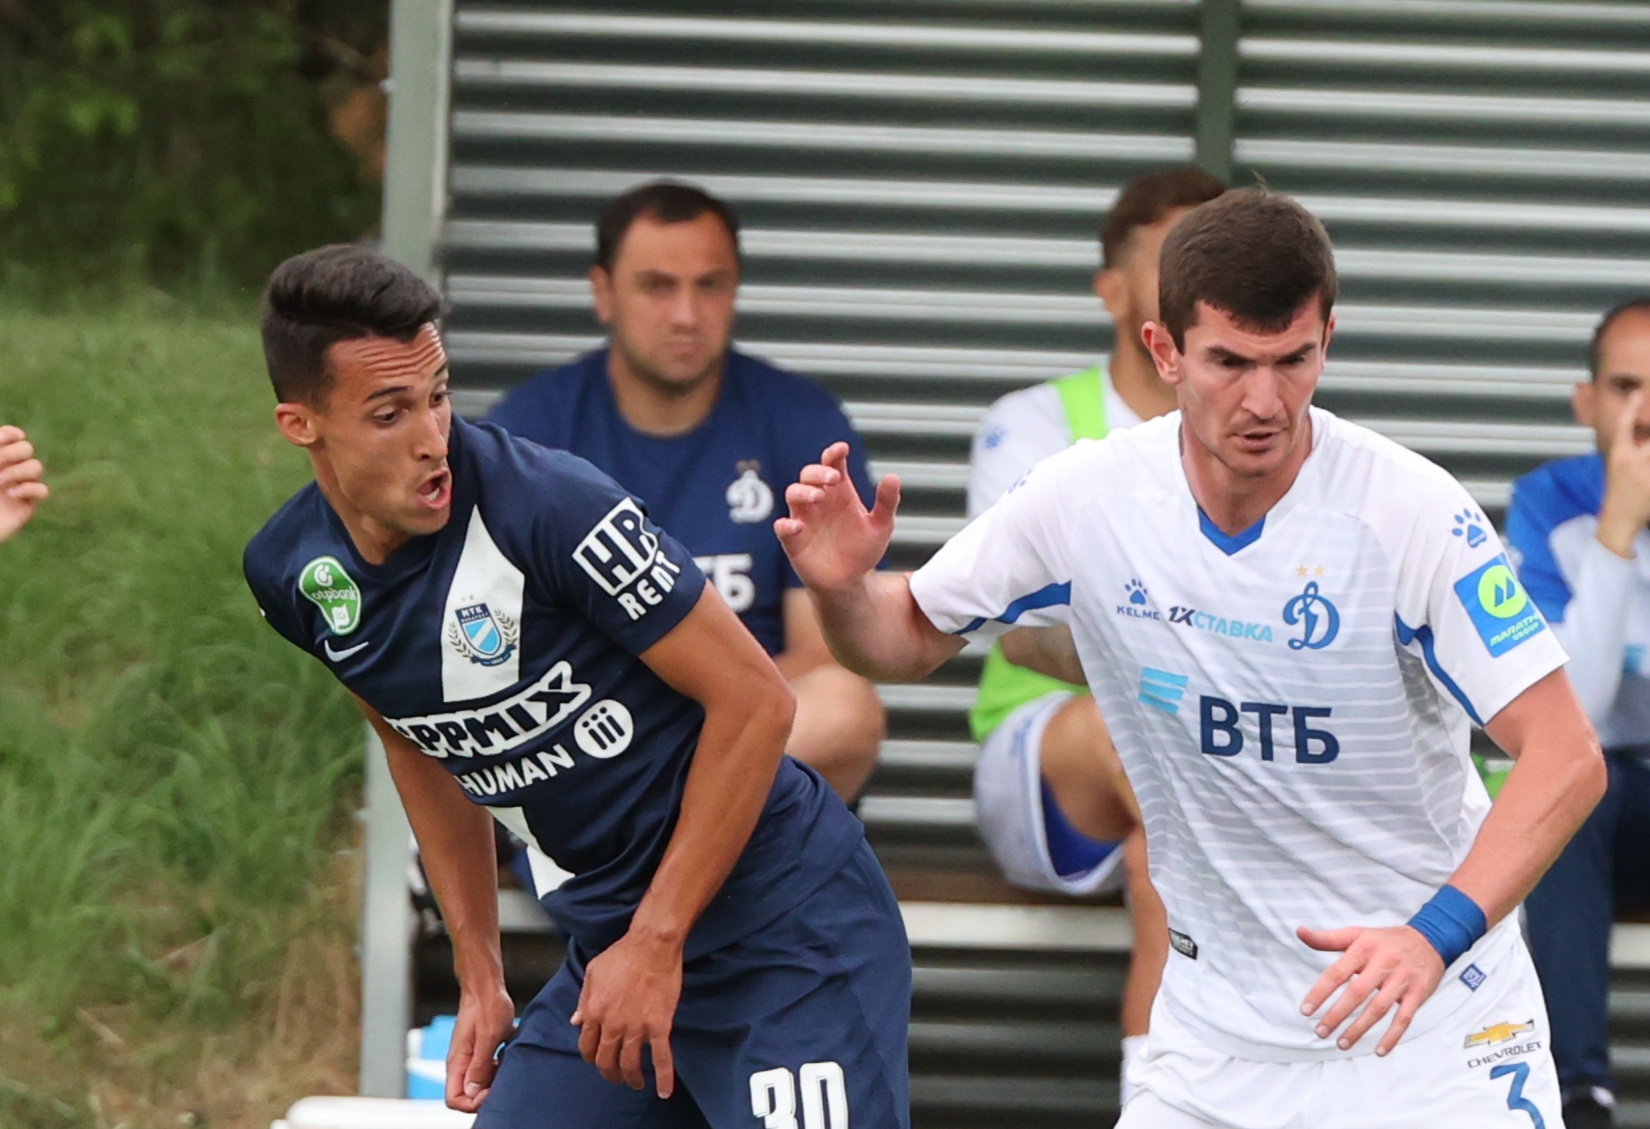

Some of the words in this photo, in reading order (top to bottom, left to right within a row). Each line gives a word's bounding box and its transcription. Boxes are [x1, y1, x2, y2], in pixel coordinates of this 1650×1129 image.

[1116, 604, 1160, 621] KELME
[385, 660, 592, 758] PPMIX
[1200, 695, 1341, 765] ВТБ
[1466, 1041, 1543, 1069] CHEVROLET
